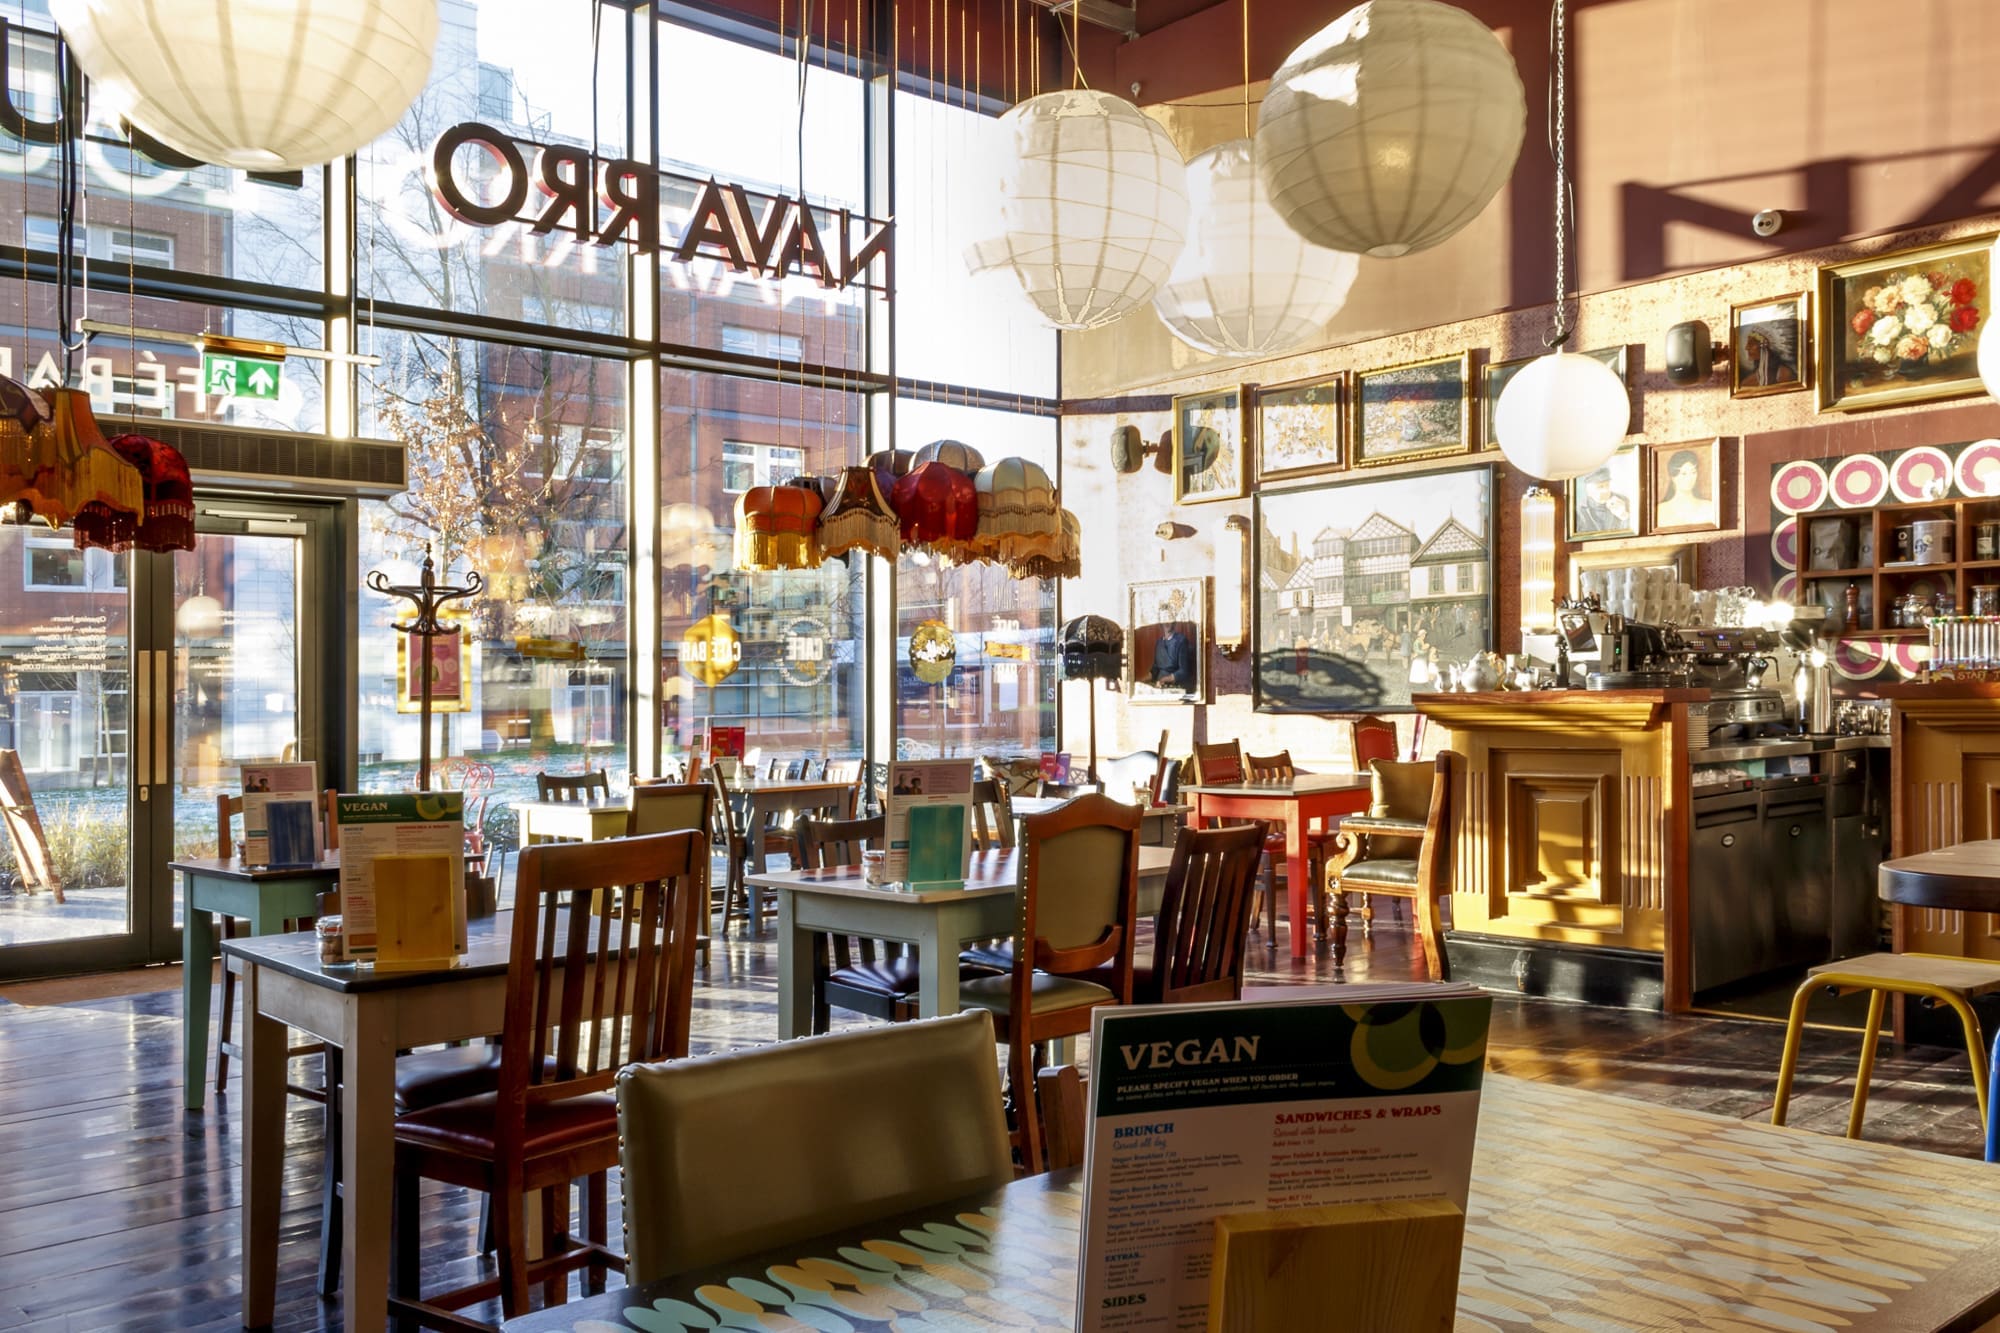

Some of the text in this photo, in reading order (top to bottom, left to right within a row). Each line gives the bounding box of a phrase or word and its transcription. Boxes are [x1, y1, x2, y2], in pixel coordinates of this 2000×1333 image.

[343, 801, 389, 813] VEGAN
[1120, 1035, 1261, 1071] VEGAN
[1117, 1072, 1299, 1094] PLEASE SPECIFY VEGAN WHEN YOU ORDER
[1274, 1104, 1442, 1125] SANDWICHES & WRAPS
[1113, 1122, 1175, 1139] BRUNCH
[1101, 1293, 1147, 1309] SIDES
